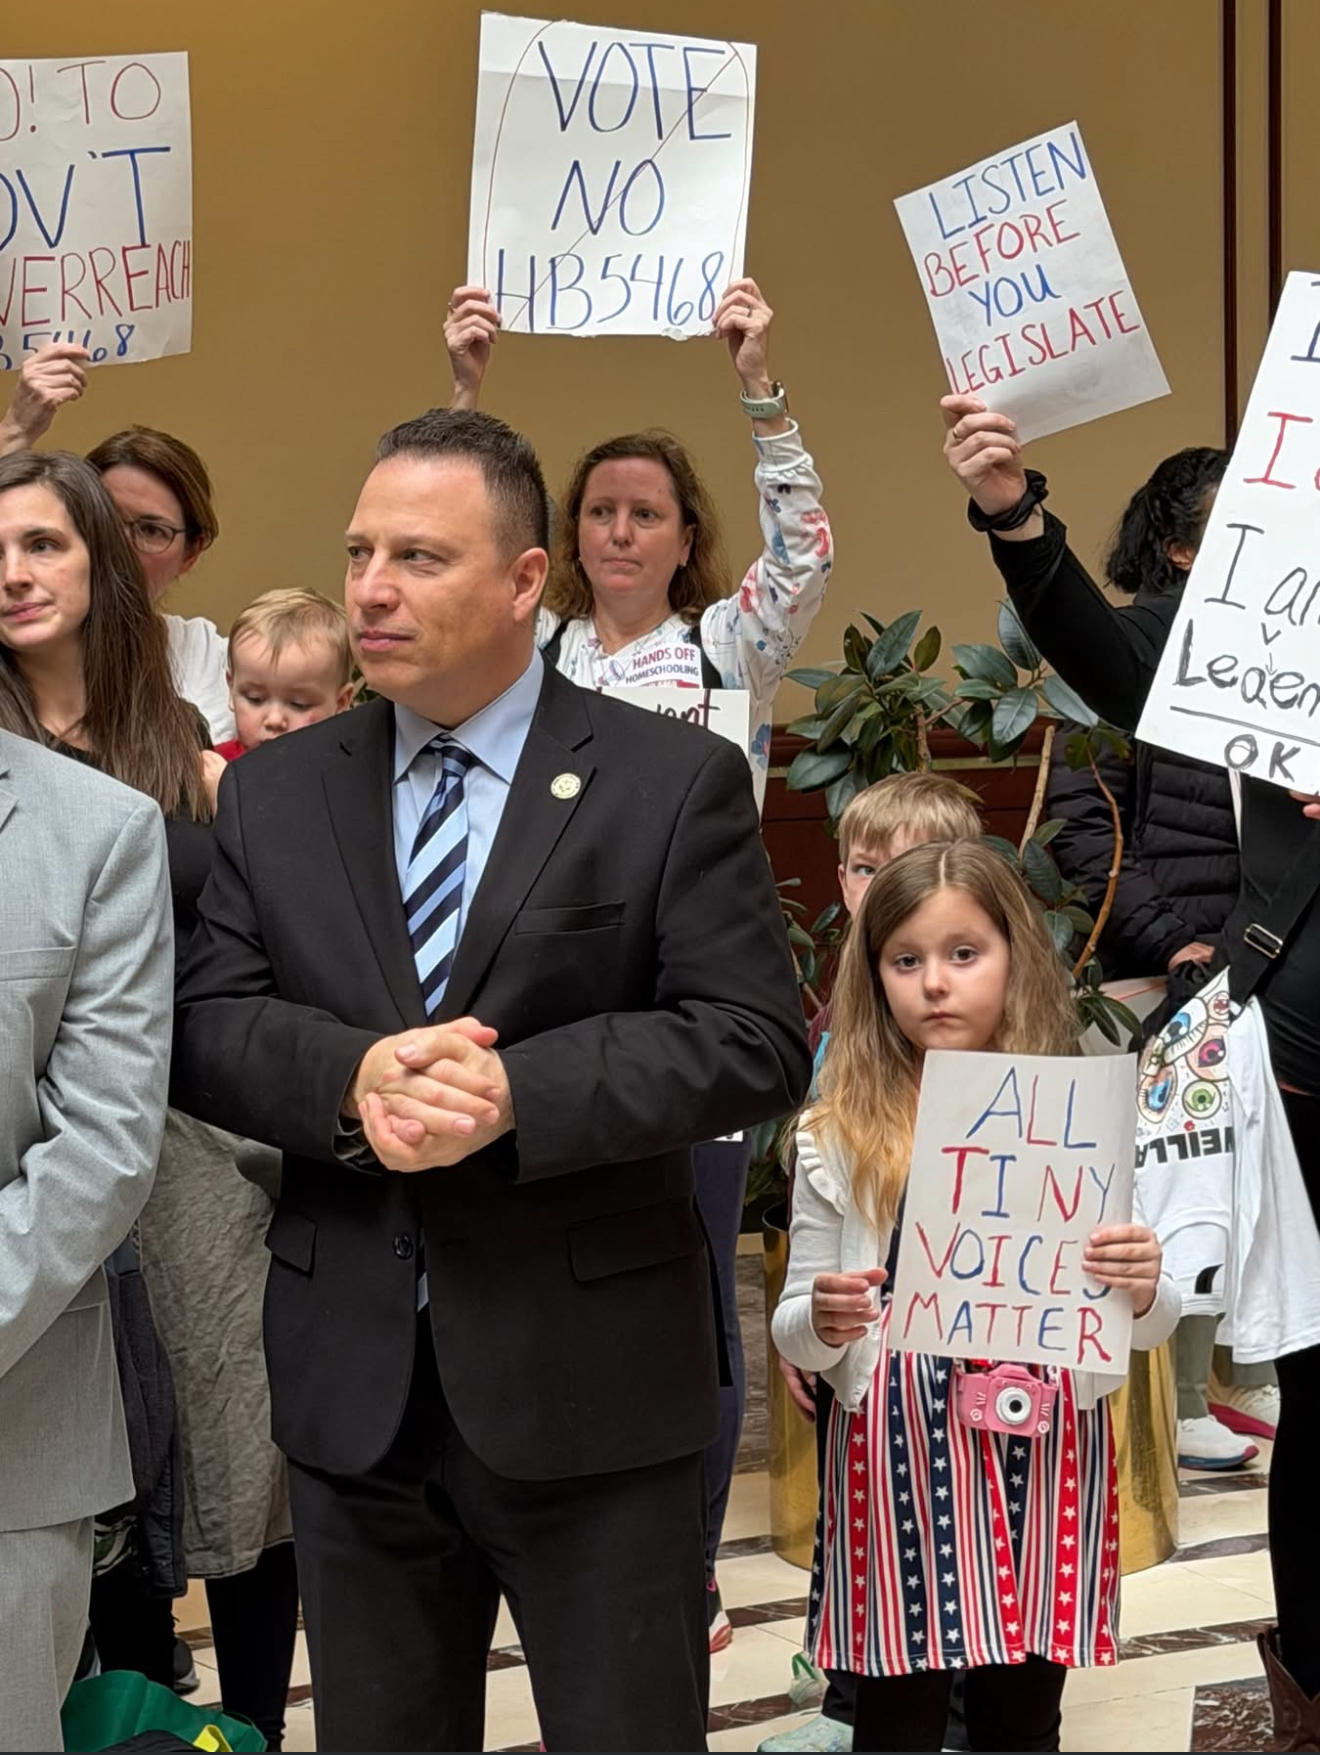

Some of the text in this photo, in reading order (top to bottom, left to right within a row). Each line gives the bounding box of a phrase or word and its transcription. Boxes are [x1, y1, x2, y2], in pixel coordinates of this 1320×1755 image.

[56, 60, 161, 125] TO
[538, 41, 731, 140] VOTE
[551, 159, 665, 236] NO
[928, 131, 1086, 240] LISTEN
[923, 198, 1081, 297] BEFORE
[496, 248, 725, 332] HB5468
[967, 263, 1062, 327] YOU
[945, 290, 1141, 396] LEGISLATE
[1243, 411, 1314, 489] I
[1204, 523, 1265, 610] I
[625, 663, 699, 684] HOMESCHOOLING
[632, 647, 695, 670] HANDS OFF
[1223, 733, 1302, 783] OK
[965, 1066, 1097, 1149] ALL
[941, 1146, 1116, 1224] TINY
[903, 1291, 1112, 1365] MATTER
